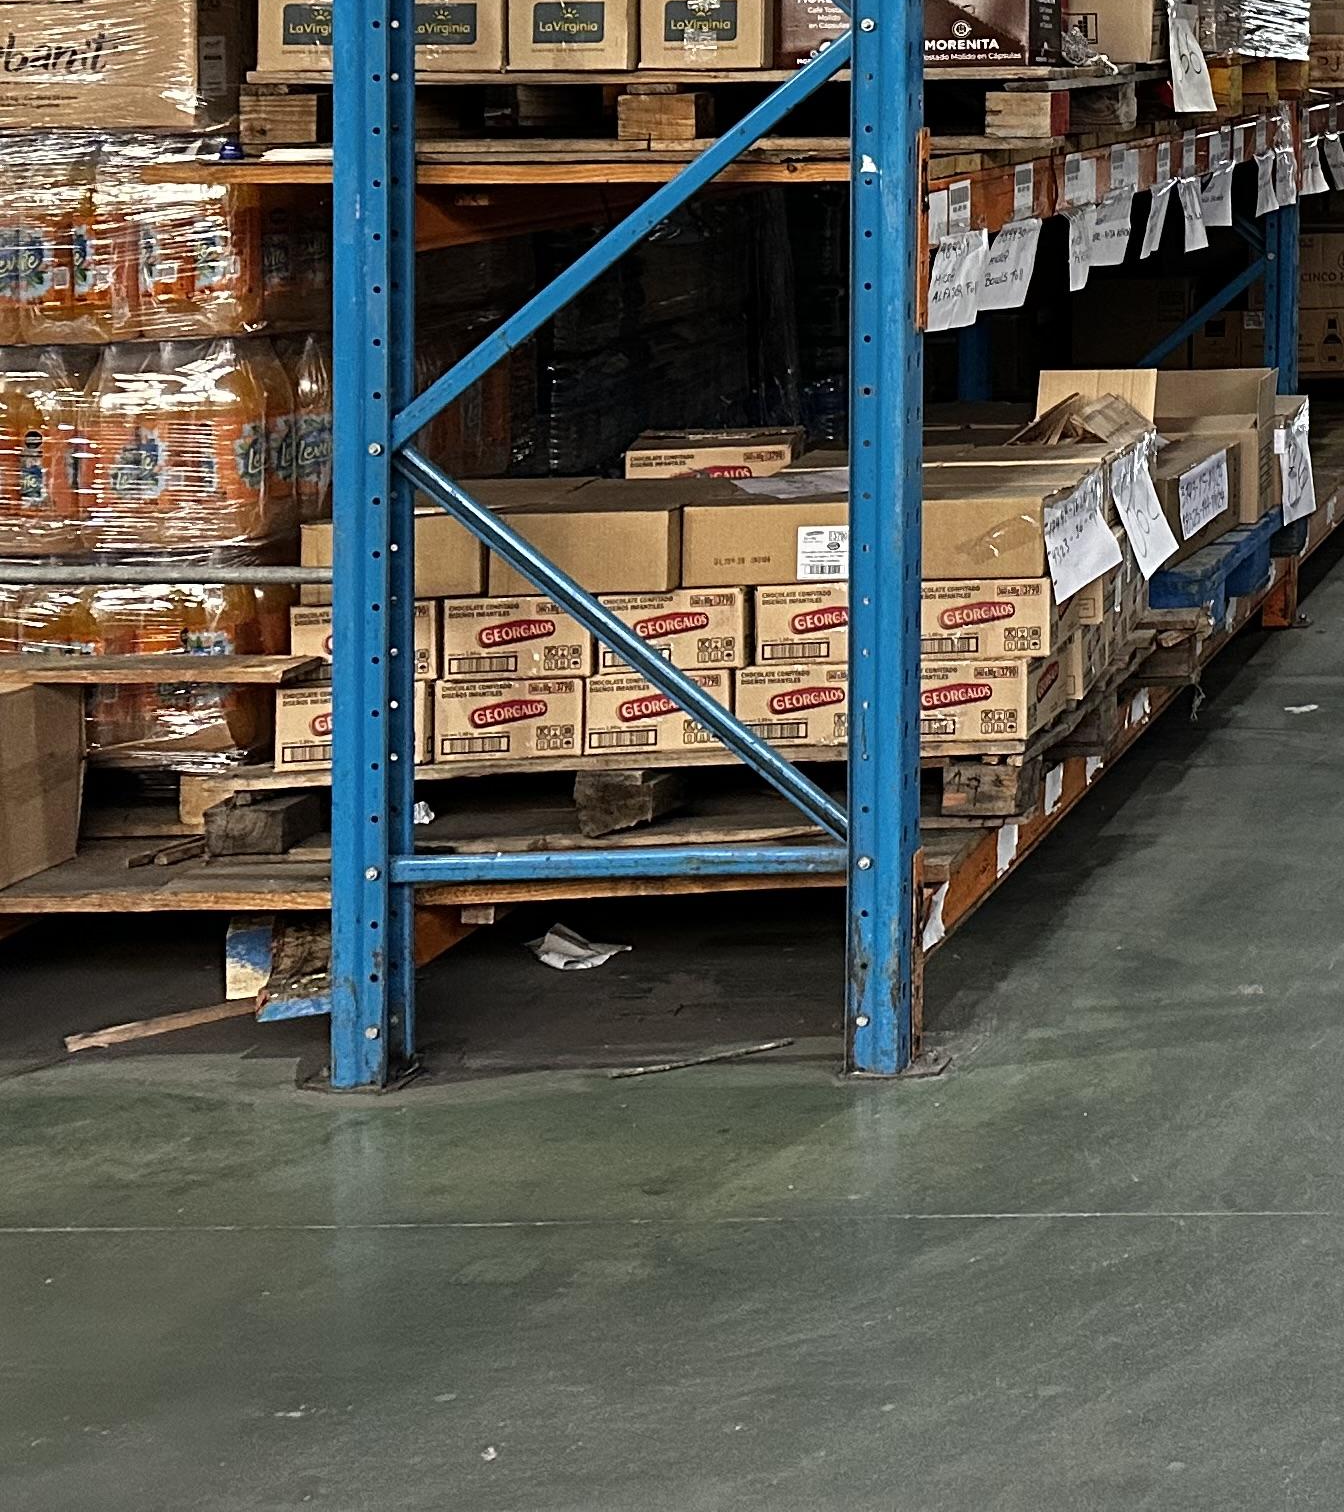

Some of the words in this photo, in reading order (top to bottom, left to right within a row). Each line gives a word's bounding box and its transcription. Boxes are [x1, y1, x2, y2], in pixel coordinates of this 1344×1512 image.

[415, 23, 470, 36] aVirginia
[925, 39, 1000, 51] MORENITA
[952, 53, 975, 61] Molido
[1302, 272, 1336, 282] CINCO
[636, 614, 707, 636] GEORGALOS
[943, 603, 1014, 625] GEORGALOS
[481, 621, 553, 644] GEORGALOS
[741, 670, 775, 678] CHOCOLATE
[773, 688, 844, 711] GEORGALOS
[921, 685, 991, 707] GEORGALOS
[473, 702, 546, 724] GEORGALOS
